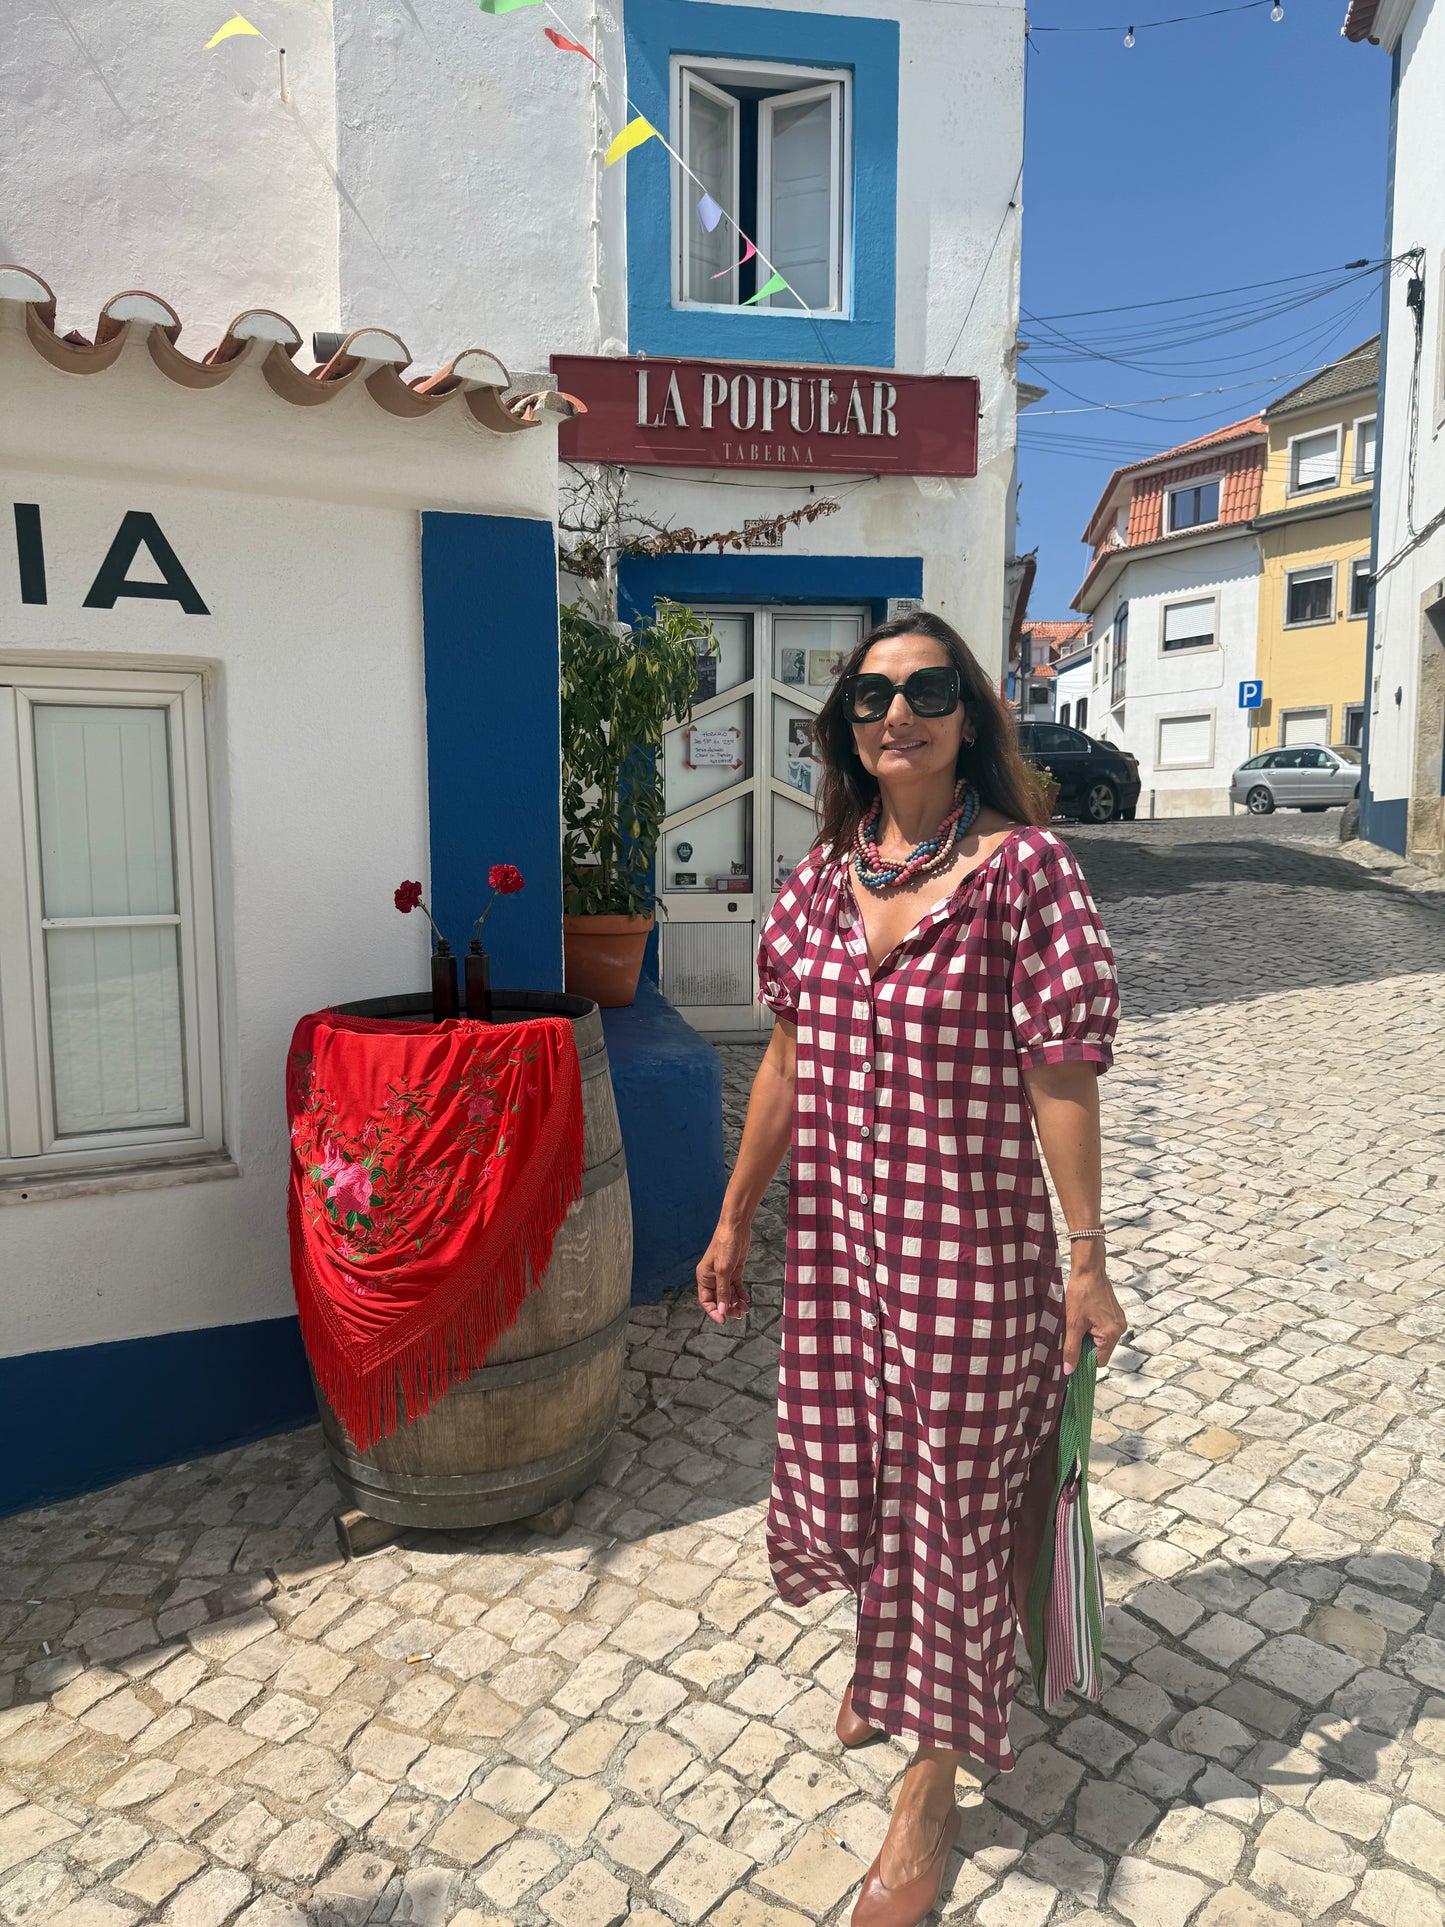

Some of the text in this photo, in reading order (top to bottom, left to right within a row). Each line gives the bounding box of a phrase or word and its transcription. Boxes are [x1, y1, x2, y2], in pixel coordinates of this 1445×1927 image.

[636, 369, 900, 437] LA POPULAR
[723, 442, 815, 463] TABERNA
[13, 502, 212, 616] IA
[1243, 683, 1258, 706] P
